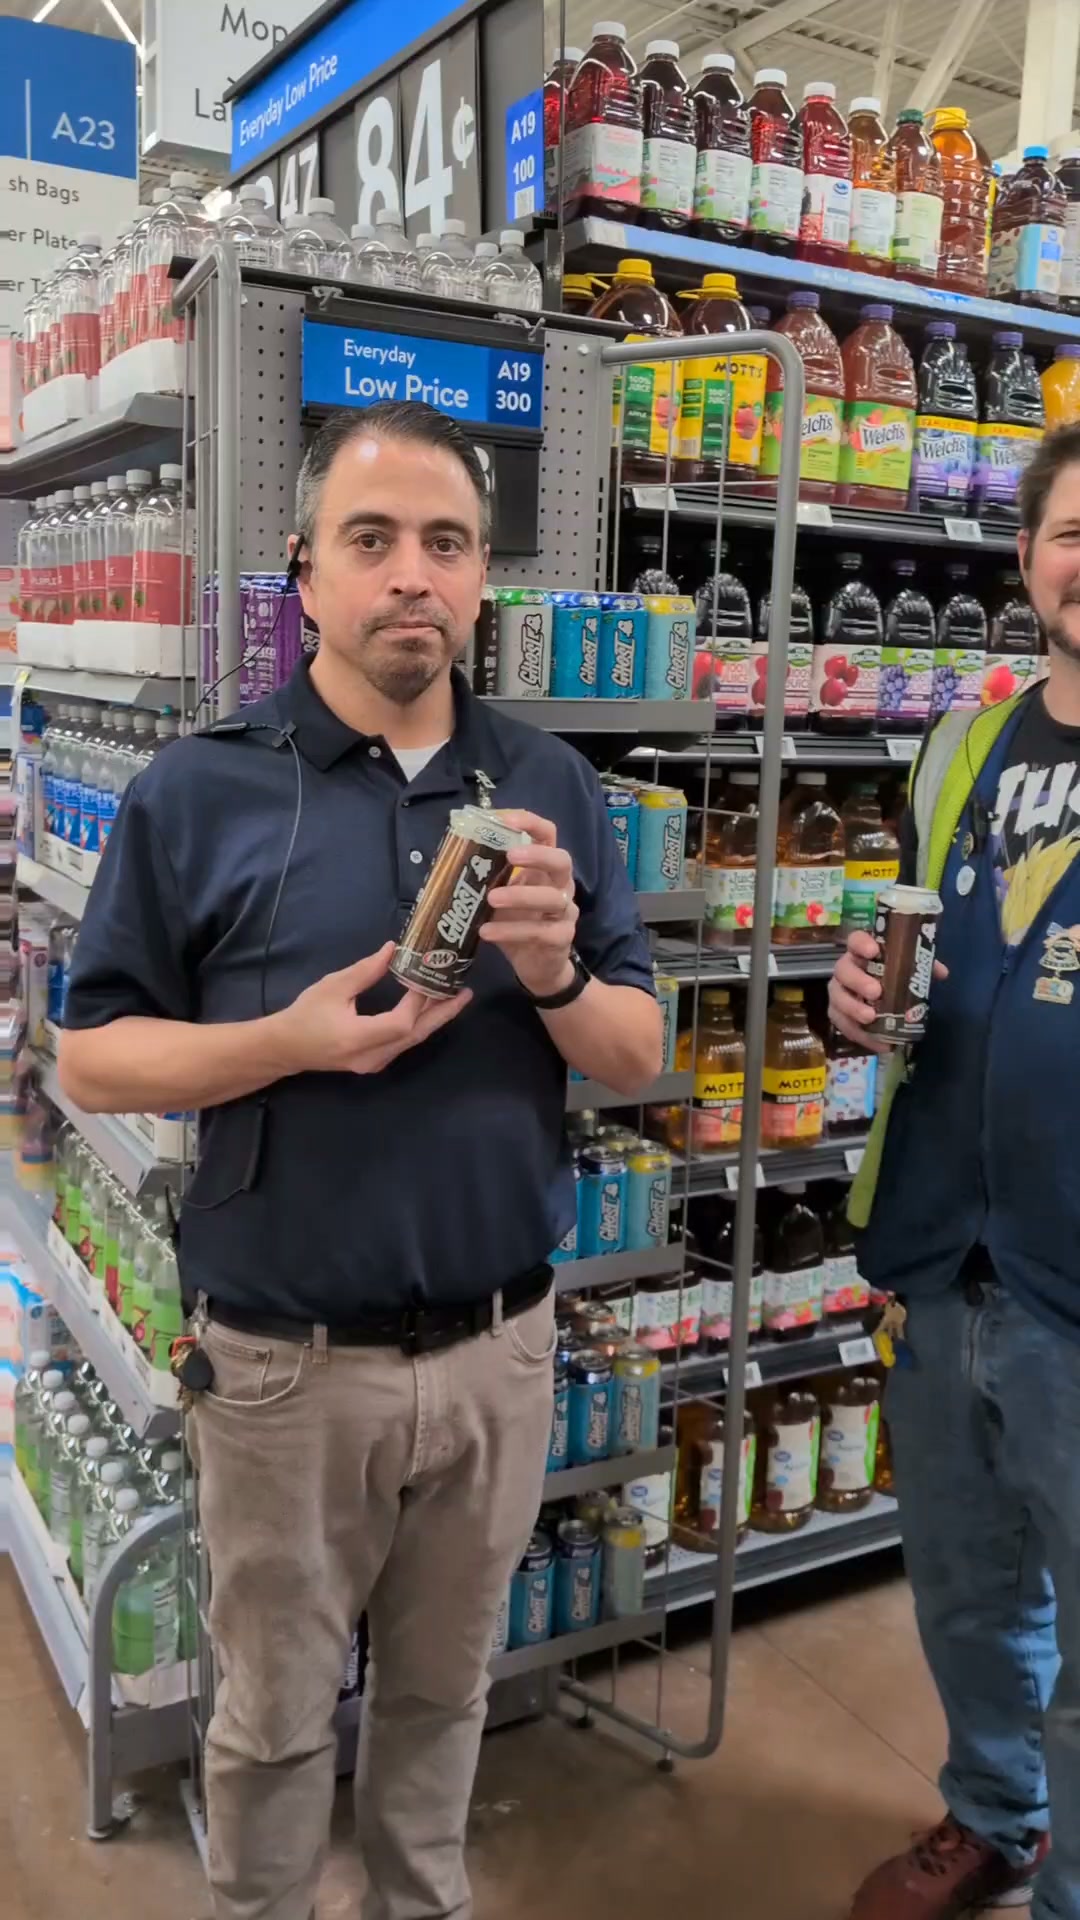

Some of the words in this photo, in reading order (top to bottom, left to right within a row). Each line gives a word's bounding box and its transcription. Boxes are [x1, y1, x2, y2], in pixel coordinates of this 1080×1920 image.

[240, 97, 284, 147] Everyday
[285, 79, 307, 112] Low
[309, 54, 338, 93] Price
[51, 111, 116, 150] A23
[511, 110, 536, 144] A19
[513, 154, 535, 185] 100
[36, 178, 80, 205] Bags
[344, 338, 416, 369] Everyday
[497, 360, 531, 383] A19
[345, 366, 397, 400] Low
[405, 374, 470, 408] Price
[495, 389, 531, 413] 300
[801, 415, 833, 437] elch's
[863, 423, 906, 446] Welch's
[921, 435, 966, 458] Welch's
[518, 623, 545, 689] GHOST
[578, 626, 599, 687] GHOST
[611, 628, 635, 689] GHOST
[666, 630, 690, 690] GHOST
[661, 823, 682, 881] GHOST
[436, 865, 487, 949] GHOST
[908, 933, 936, 999] GHOST
